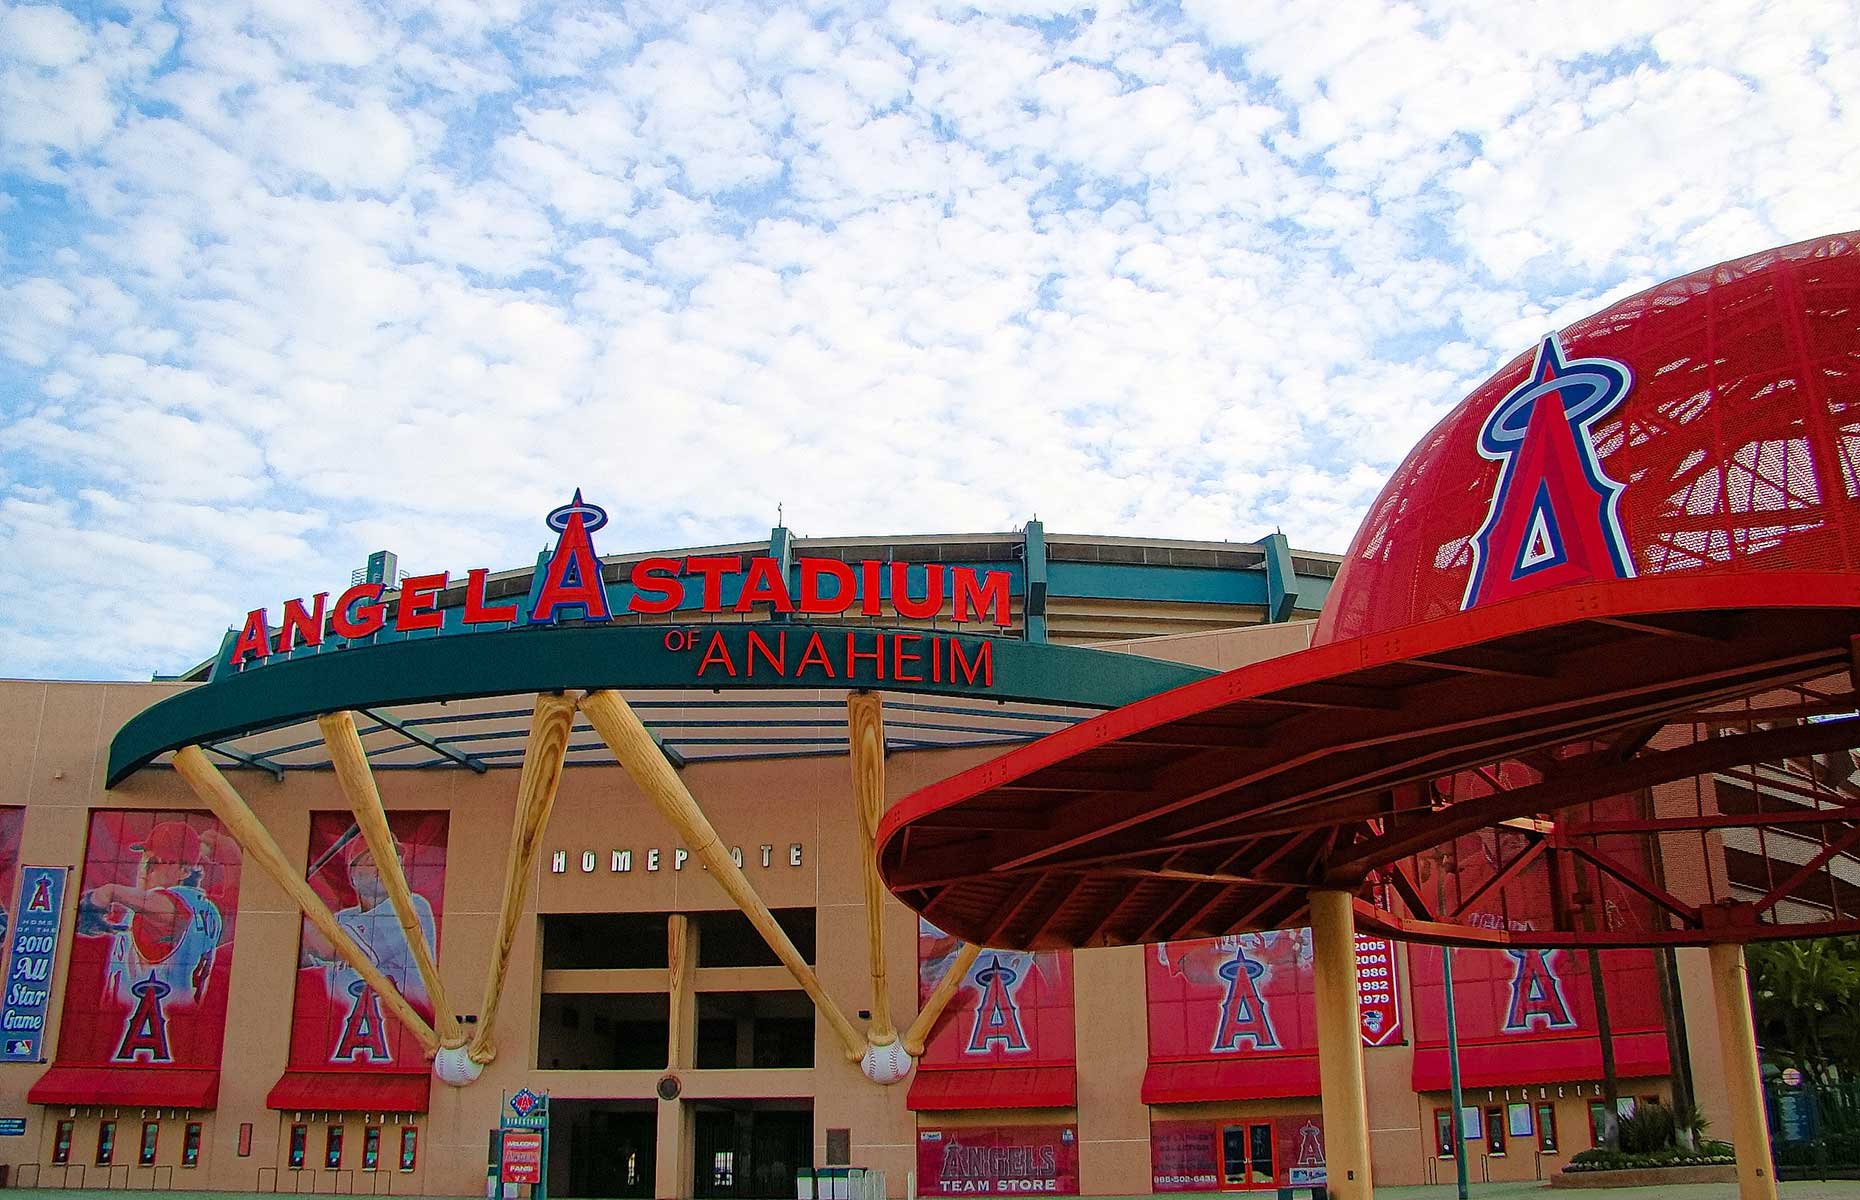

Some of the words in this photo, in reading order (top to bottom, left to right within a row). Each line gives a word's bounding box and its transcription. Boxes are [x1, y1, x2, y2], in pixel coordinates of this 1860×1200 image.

[1460, 331, 1637, 611] A
[628, 554, 1013, 628] STADIUM
[664, 629, 701, 653] OF
[697, 630, 994, 688] ANAHEIM
[16, 935, 54, 954] 2010
[1354, 941, 1386, 951] 2005
[13, 957, 49, 981] All
[1355, 954, 1387, 964] 2004
[8, 983, 47, 1006] Star
[3, 1009, 43, 1030] Game
[940, 1130, 1056, 1177] ANGELS
[940, 1180, 990, 1192] TEAM
[998, 1179, 1056, 1191] STORE
